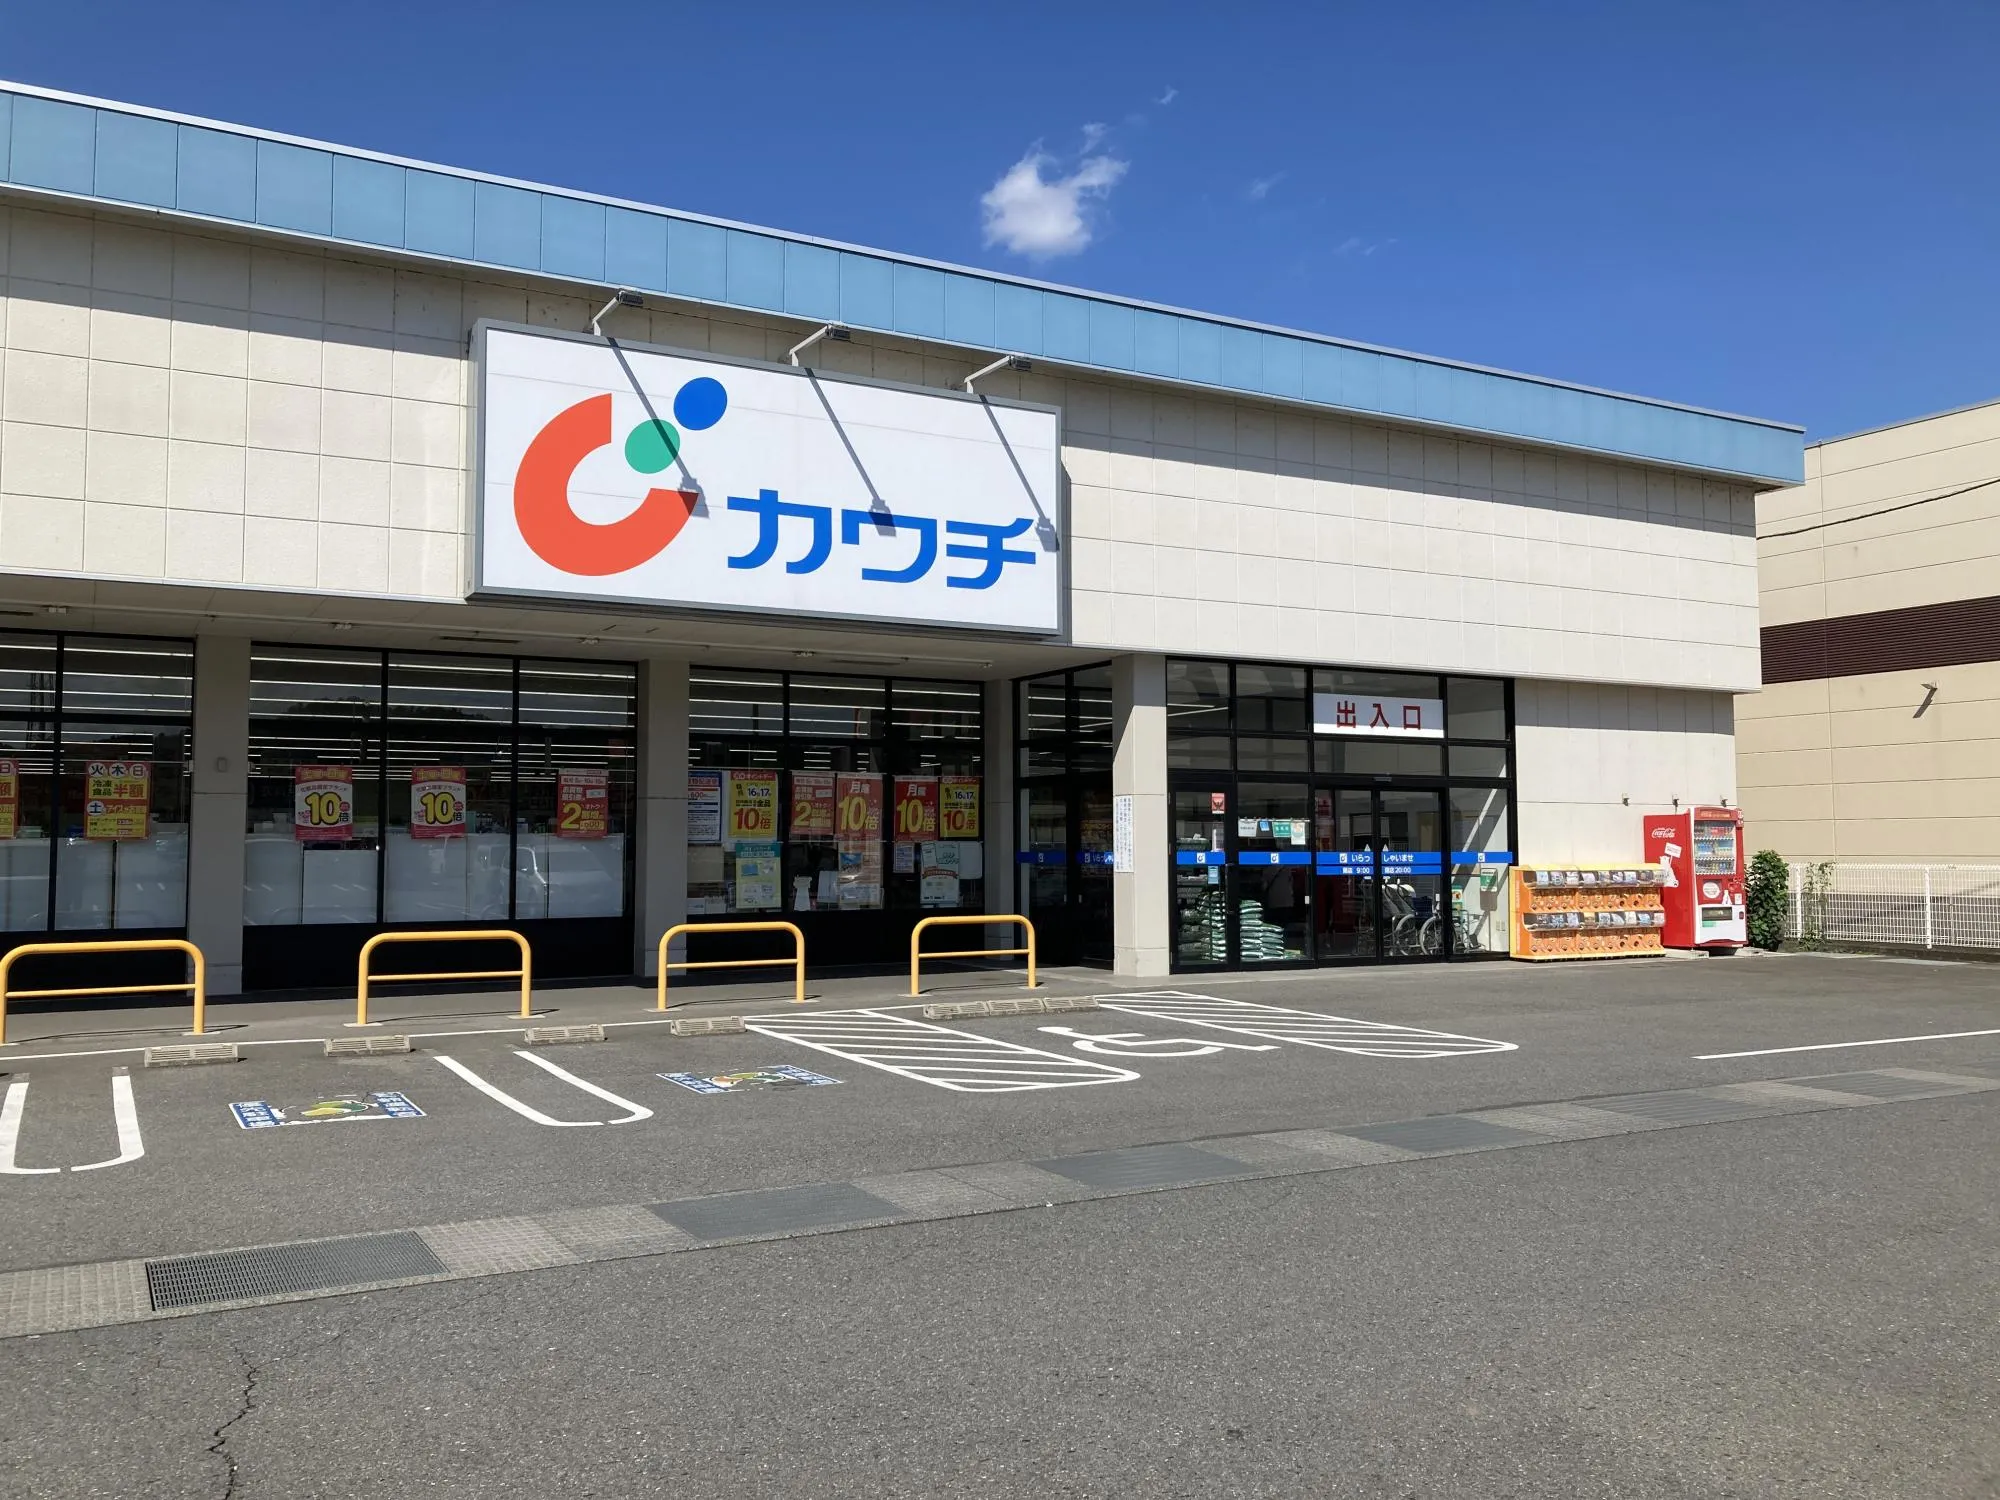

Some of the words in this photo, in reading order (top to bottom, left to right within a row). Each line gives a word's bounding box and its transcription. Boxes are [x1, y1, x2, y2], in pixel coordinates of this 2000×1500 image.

[727, 488, 1036, 590] カワチ
[1337, 700, 1421, 730] 出入口
